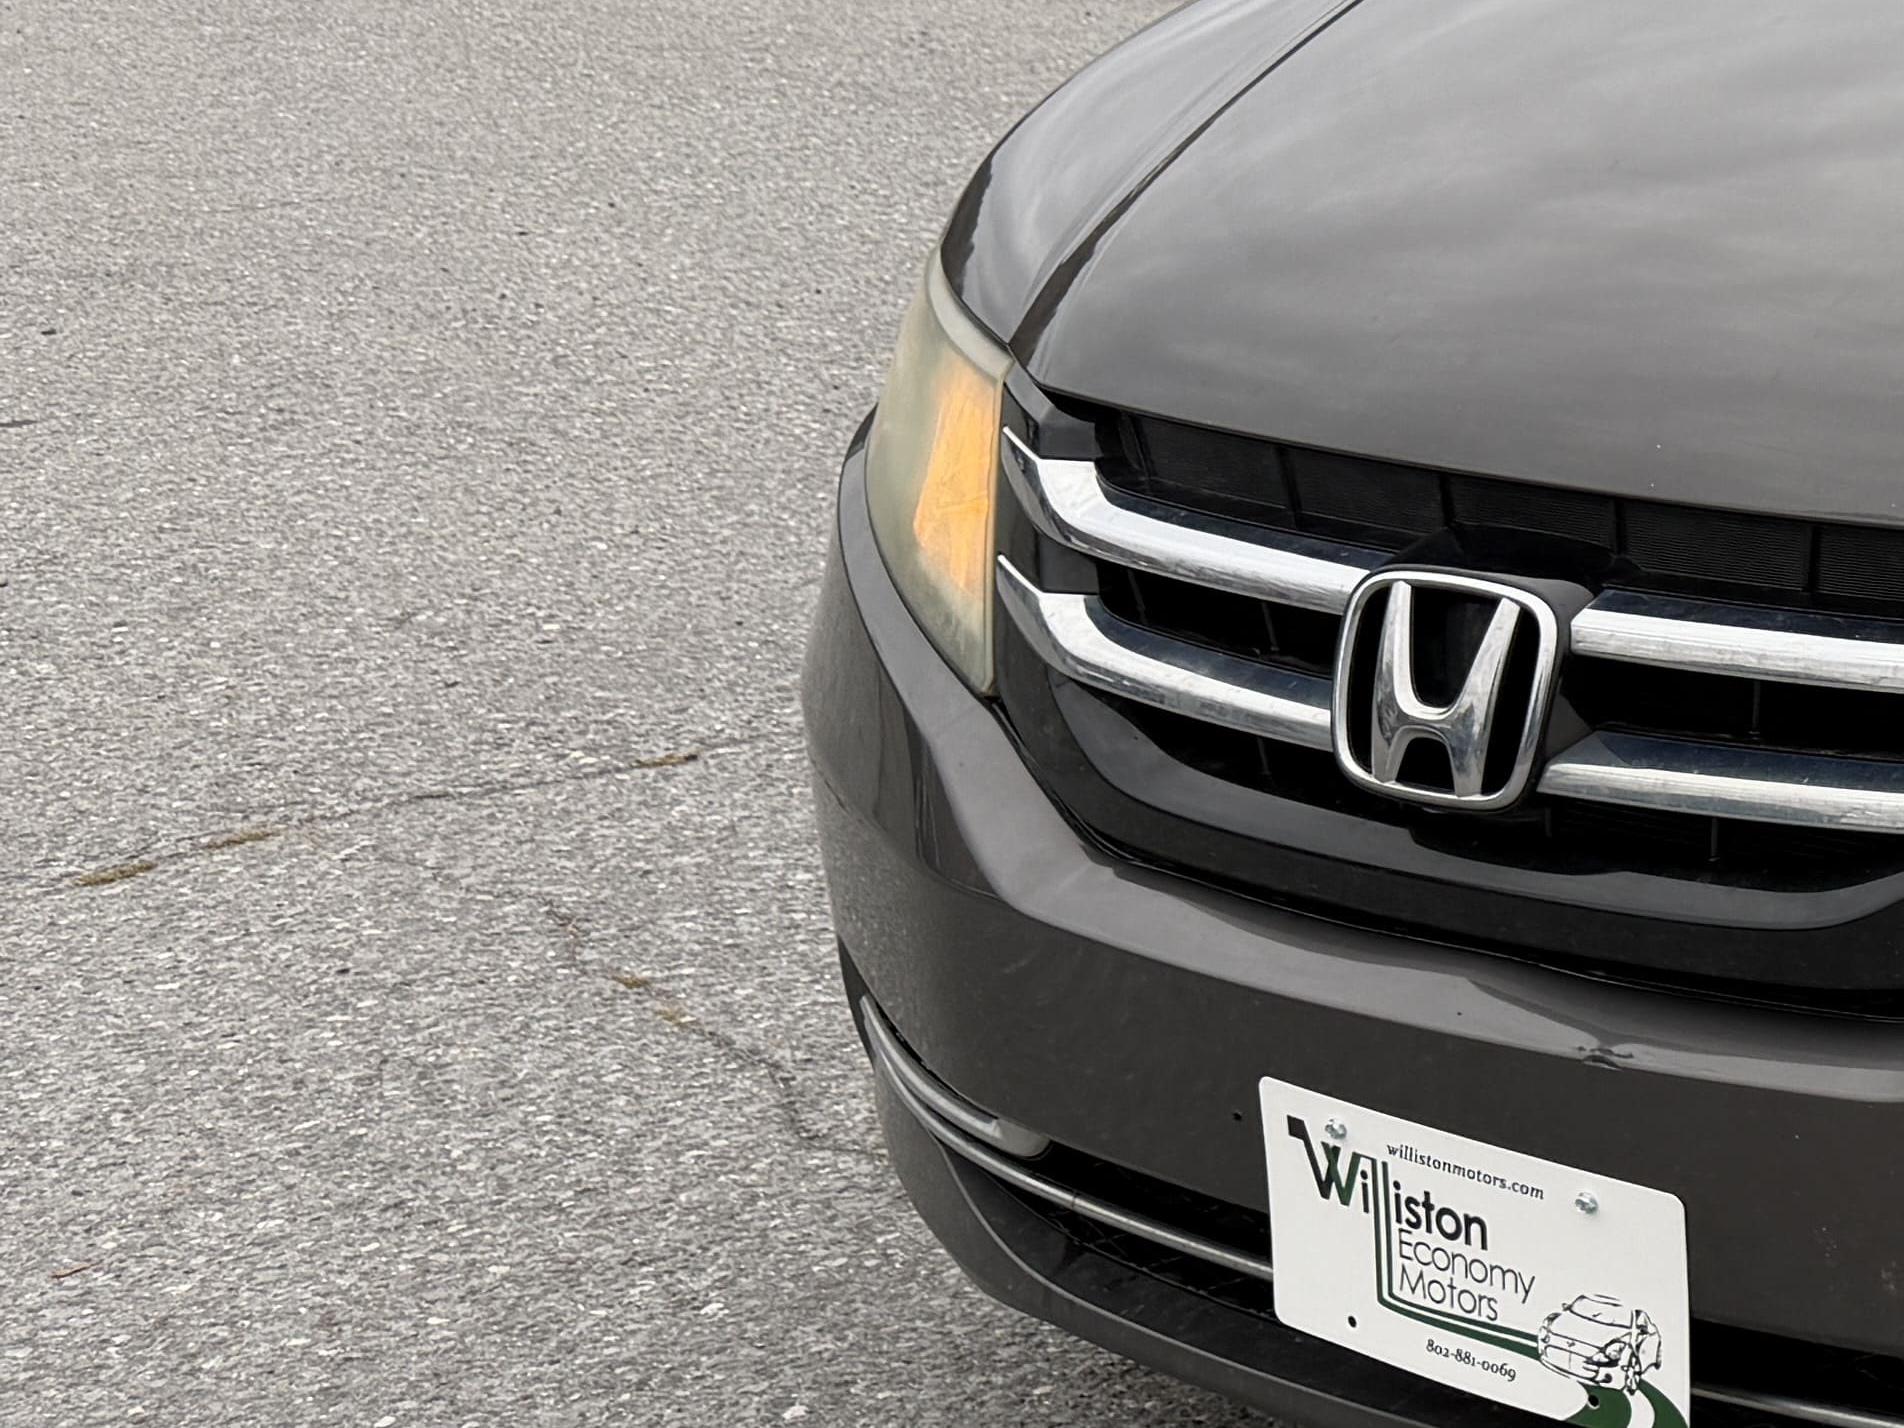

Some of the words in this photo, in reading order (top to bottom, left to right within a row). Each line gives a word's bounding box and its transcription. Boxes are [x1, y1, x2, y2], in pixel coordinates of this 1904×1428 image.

[1286, 1114, 1489, 1251] Williston
[1387, 1142, 1545, 1201] willistonmotors.com
[1398, 1228, 1536, 1305] Economy
[1400, 1265, 1499, 1322] Motors
[1426, 1337, 1517, 1383] 802-881-0069
